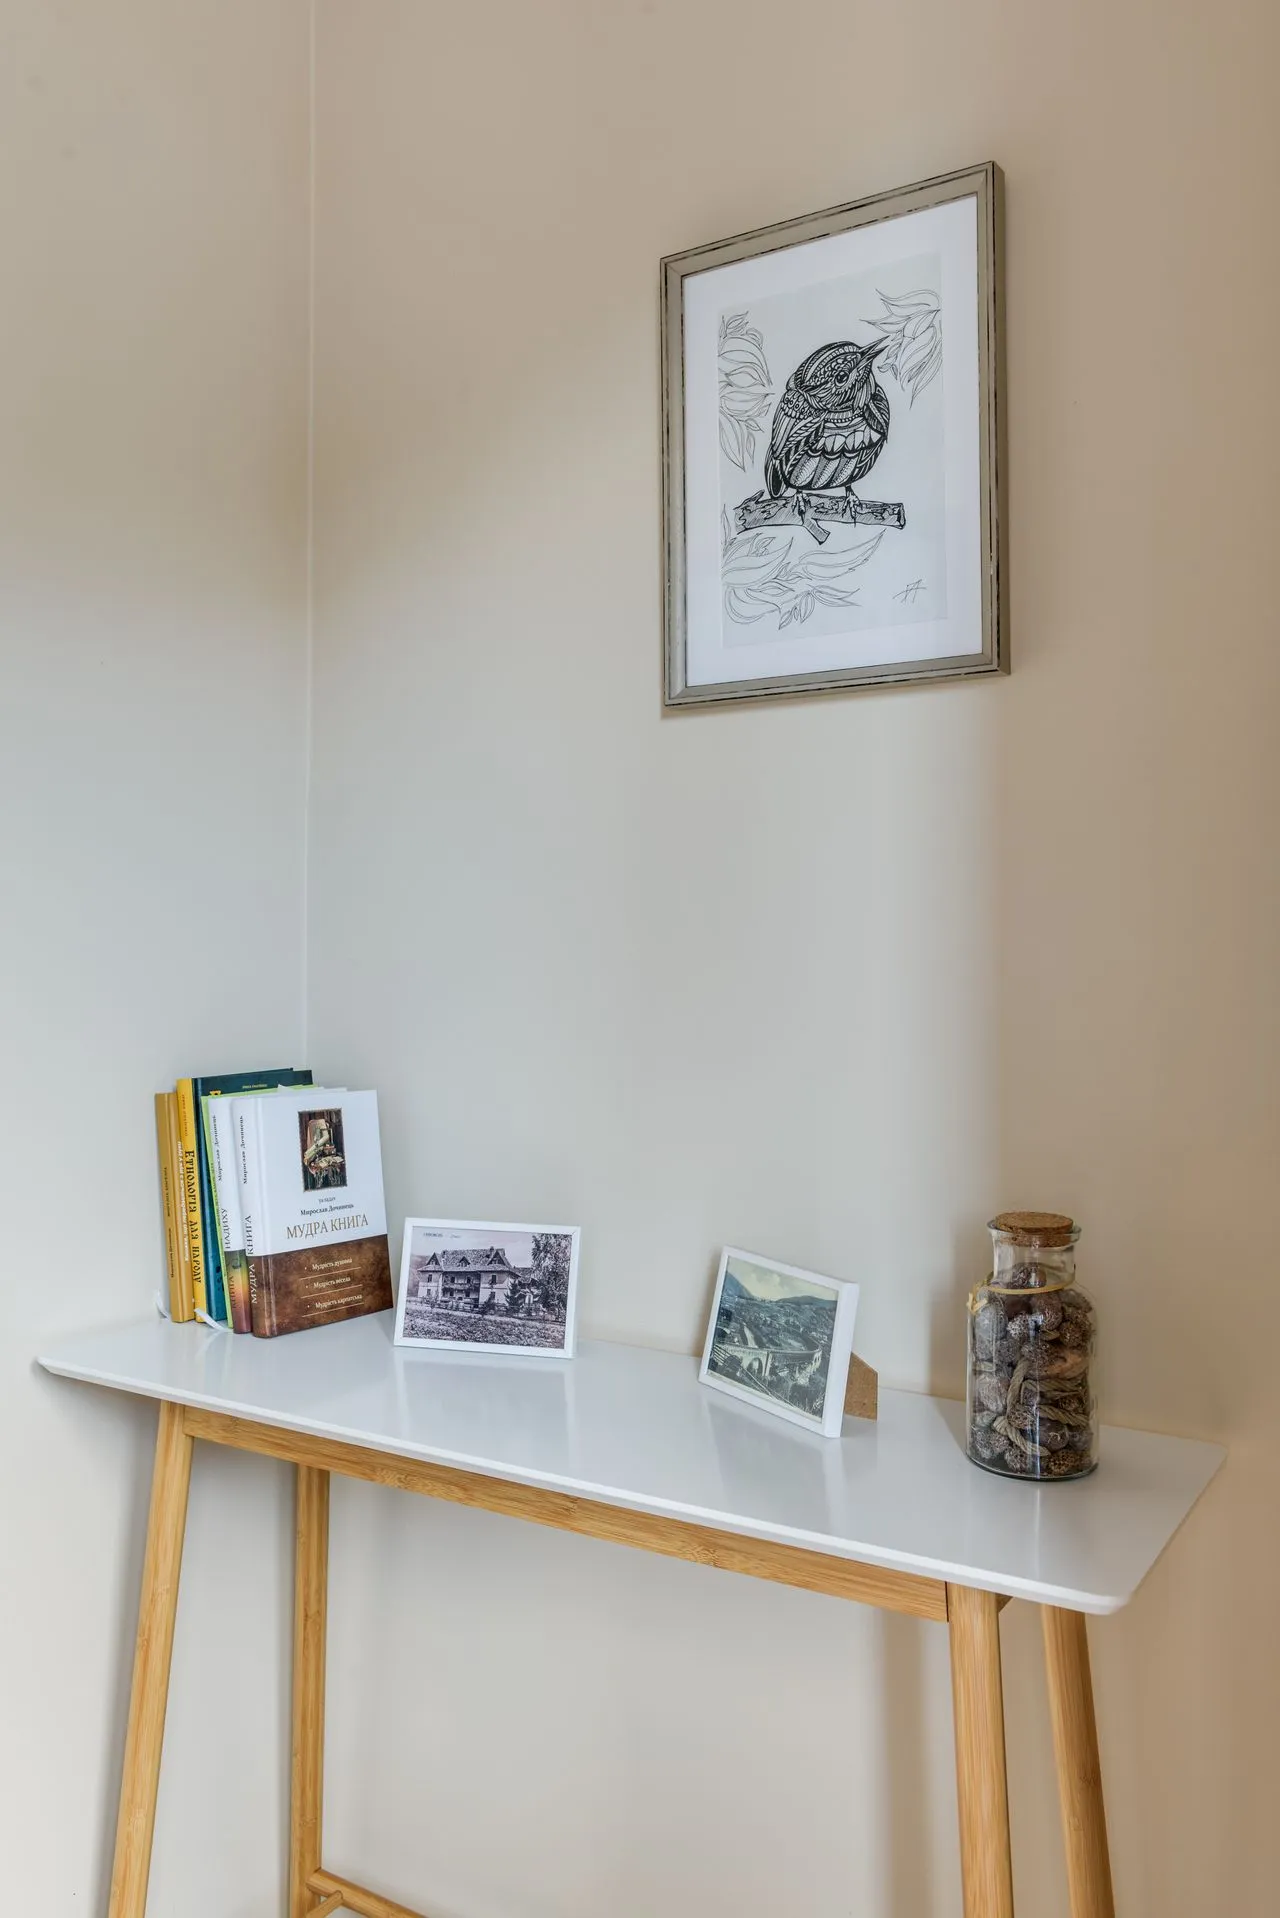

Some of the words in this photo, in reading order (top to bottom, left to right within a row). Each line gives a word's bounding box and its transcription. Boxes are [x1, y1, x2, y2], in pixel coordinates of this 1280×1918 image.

[221, 1208, 231, 1249] НАДИХУ
[286, 1220, 328, 1239] МУДРА
[330, 1213, 369, 1232] КНИГА
[300, 1207, 328, 1217] Мирослав
[328, 1203, 354, 1212] Дочинець
[244, 1215, 254, 1255] КНИГА
[248, 1263, 257, 1304] МУДРА
